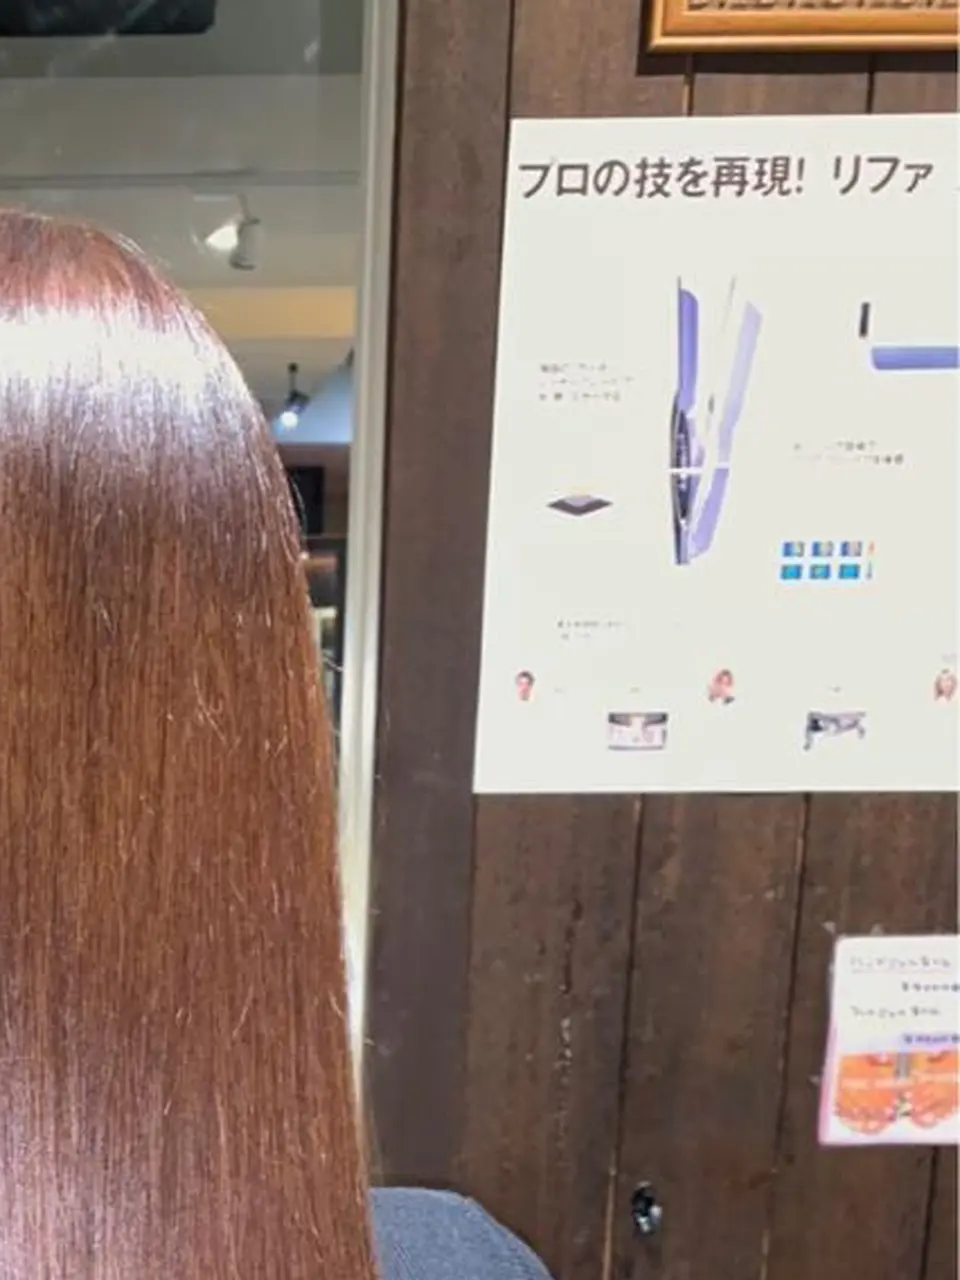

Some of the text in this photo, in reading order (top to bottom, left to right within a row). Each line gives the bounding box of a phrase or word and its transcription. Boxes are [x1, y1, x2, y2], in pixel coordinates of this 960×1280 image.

[518, 154, 936, 199] プロの技を再現! リファ
